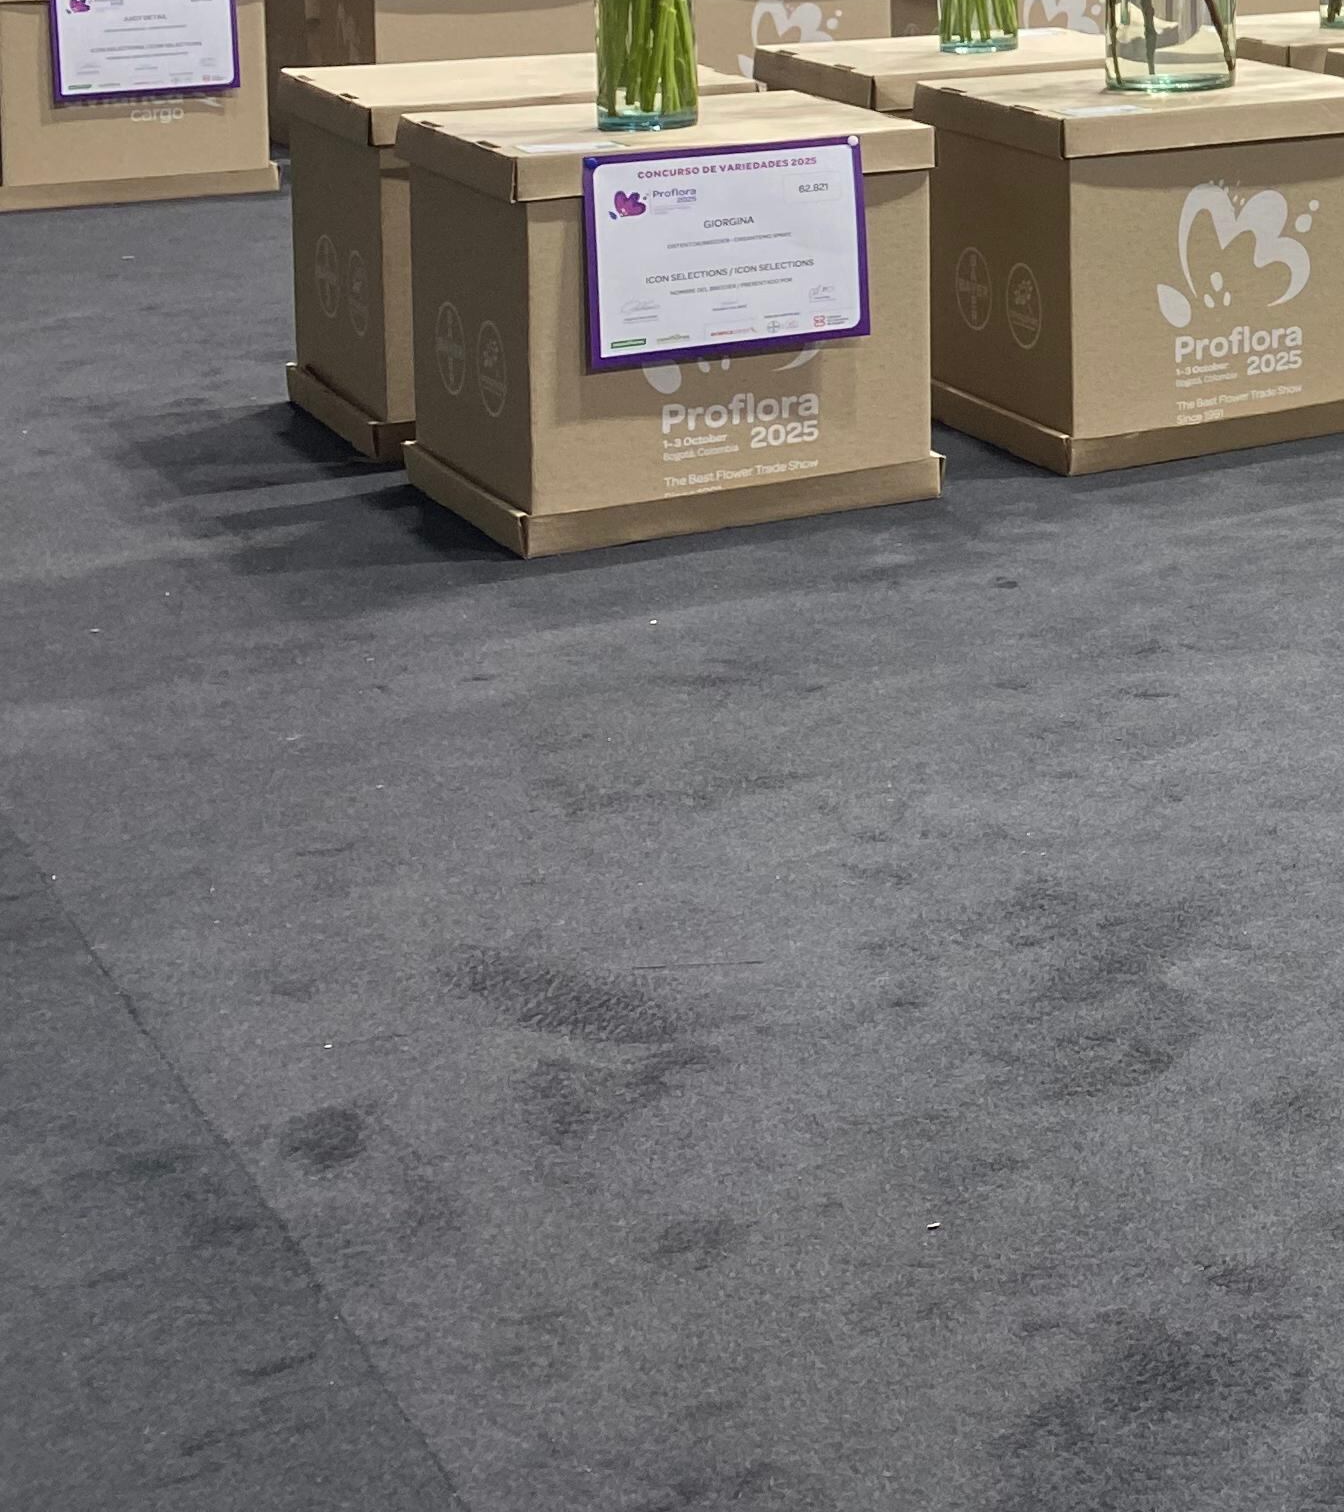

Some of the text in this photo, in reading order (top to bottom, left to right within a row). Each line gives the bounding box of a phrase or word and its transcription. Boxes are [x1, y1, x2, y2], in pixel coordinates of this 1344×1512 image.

[130, 106, 184, 124] cargo
[637, 157, 817, 179] CONCURSO DE VARIEDADES 2025
[652, 187, 697, 199] Proflora
[703, 215, 755, 229] GIORGINA
[645, 274, 669, 285] ICON
[671, 267, 728, 282] SELECTIONS
[734, 264, 757, 275] ICON
[758, 258, 815, 273] SELECTIONS
[1175, 326, 1303, 363] Proflora
[1247, 350, 1303, 376] 2025
[661, 392, 819, 434] Proflora
[1176, 401, 1196, 410] The
[663, 433, 728, 449] 1-3 October
[750, 420, 819, 449] 2025
[664, 459, 819, 487] The Best Flower Trade Show
